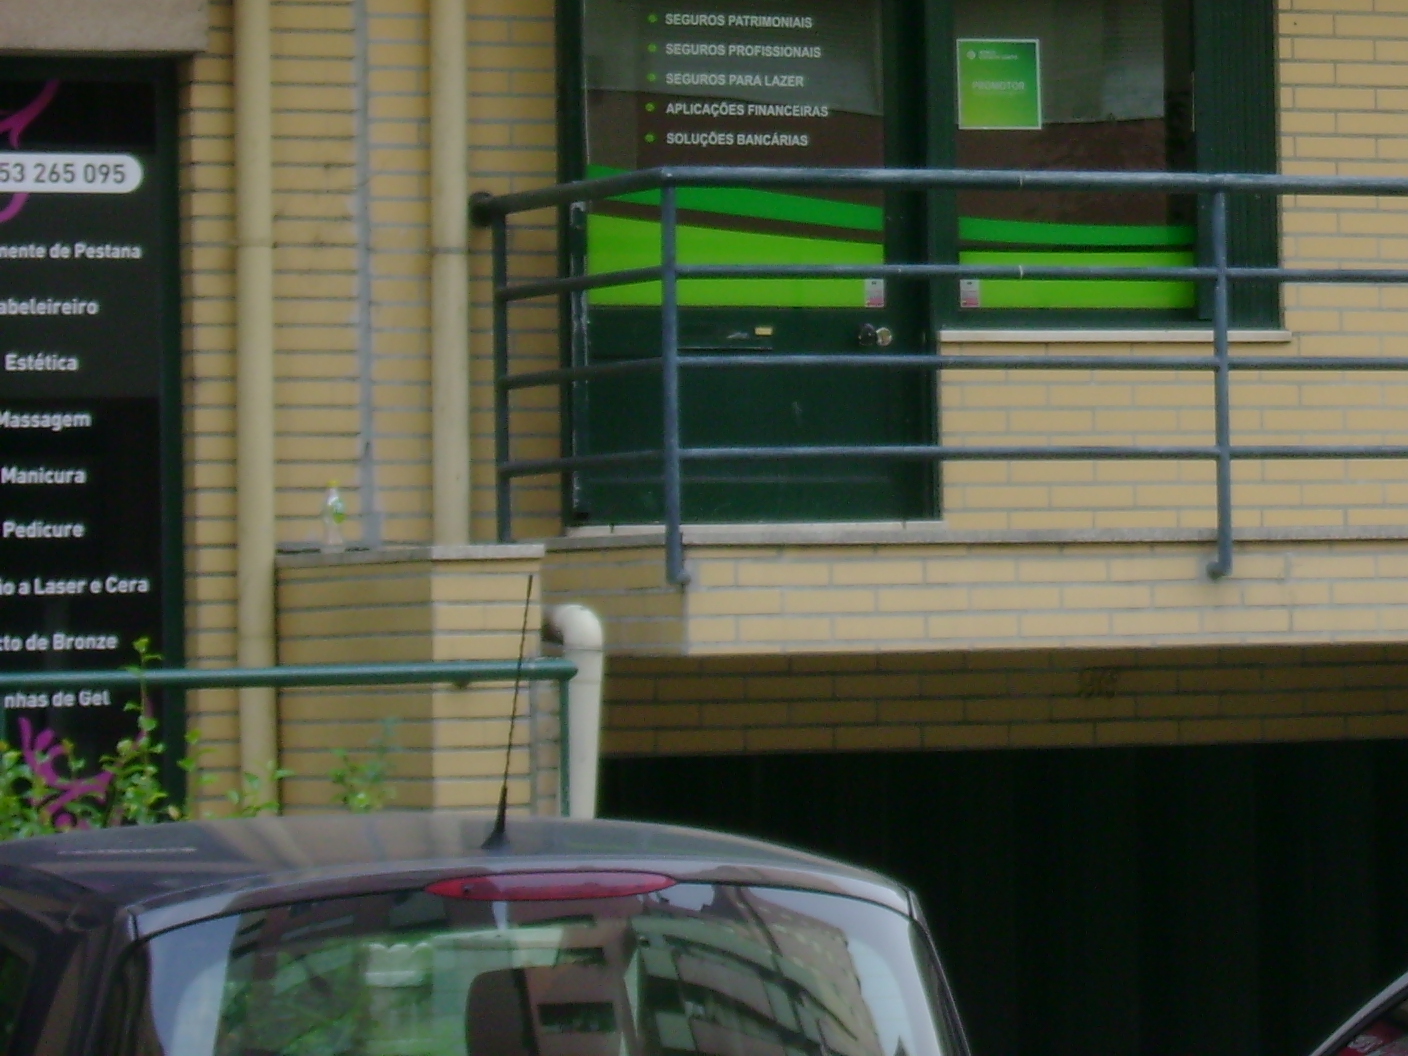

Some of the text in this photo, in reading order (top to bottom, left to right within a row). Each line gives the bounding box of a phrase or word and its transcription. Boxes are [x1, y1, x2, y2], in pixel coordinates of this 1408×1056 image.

[665, 13, 813, 29] SEGUROS PATRIMONIAIS
[665, 43, 822, 58] SEGUROS PROFISSIONAIS
[665, 73, 805, 87] SEGUROS PARA LAZER
[665, 102, 829, 118] APLICAÇÕES FINANCEIRAS
[666, 131, 808, 147] SOLUÇÕES BANCÁRIAS
[0, 162, 126, 184] 53 265 095
[49, 242, 71, 259] de
[74, 243, 143, 259] Pestana
[0, 297, 100, 315] abeleireiro
[4, 352, 79, 371] Estética
[0, 466, 87, 484] Manicura
[2, 520, 85, 538] Pedicure
[18, 581, 31, 595] a
[33, 577, 87, 595] Laser
[90, 581, 102, 594] e
[105, 575, 149, 594] Cera
[25, 633, 49, 651] de
[52, 632, 119, 650] Bronze
[3, 690, 111, 709] nhas de Gel
